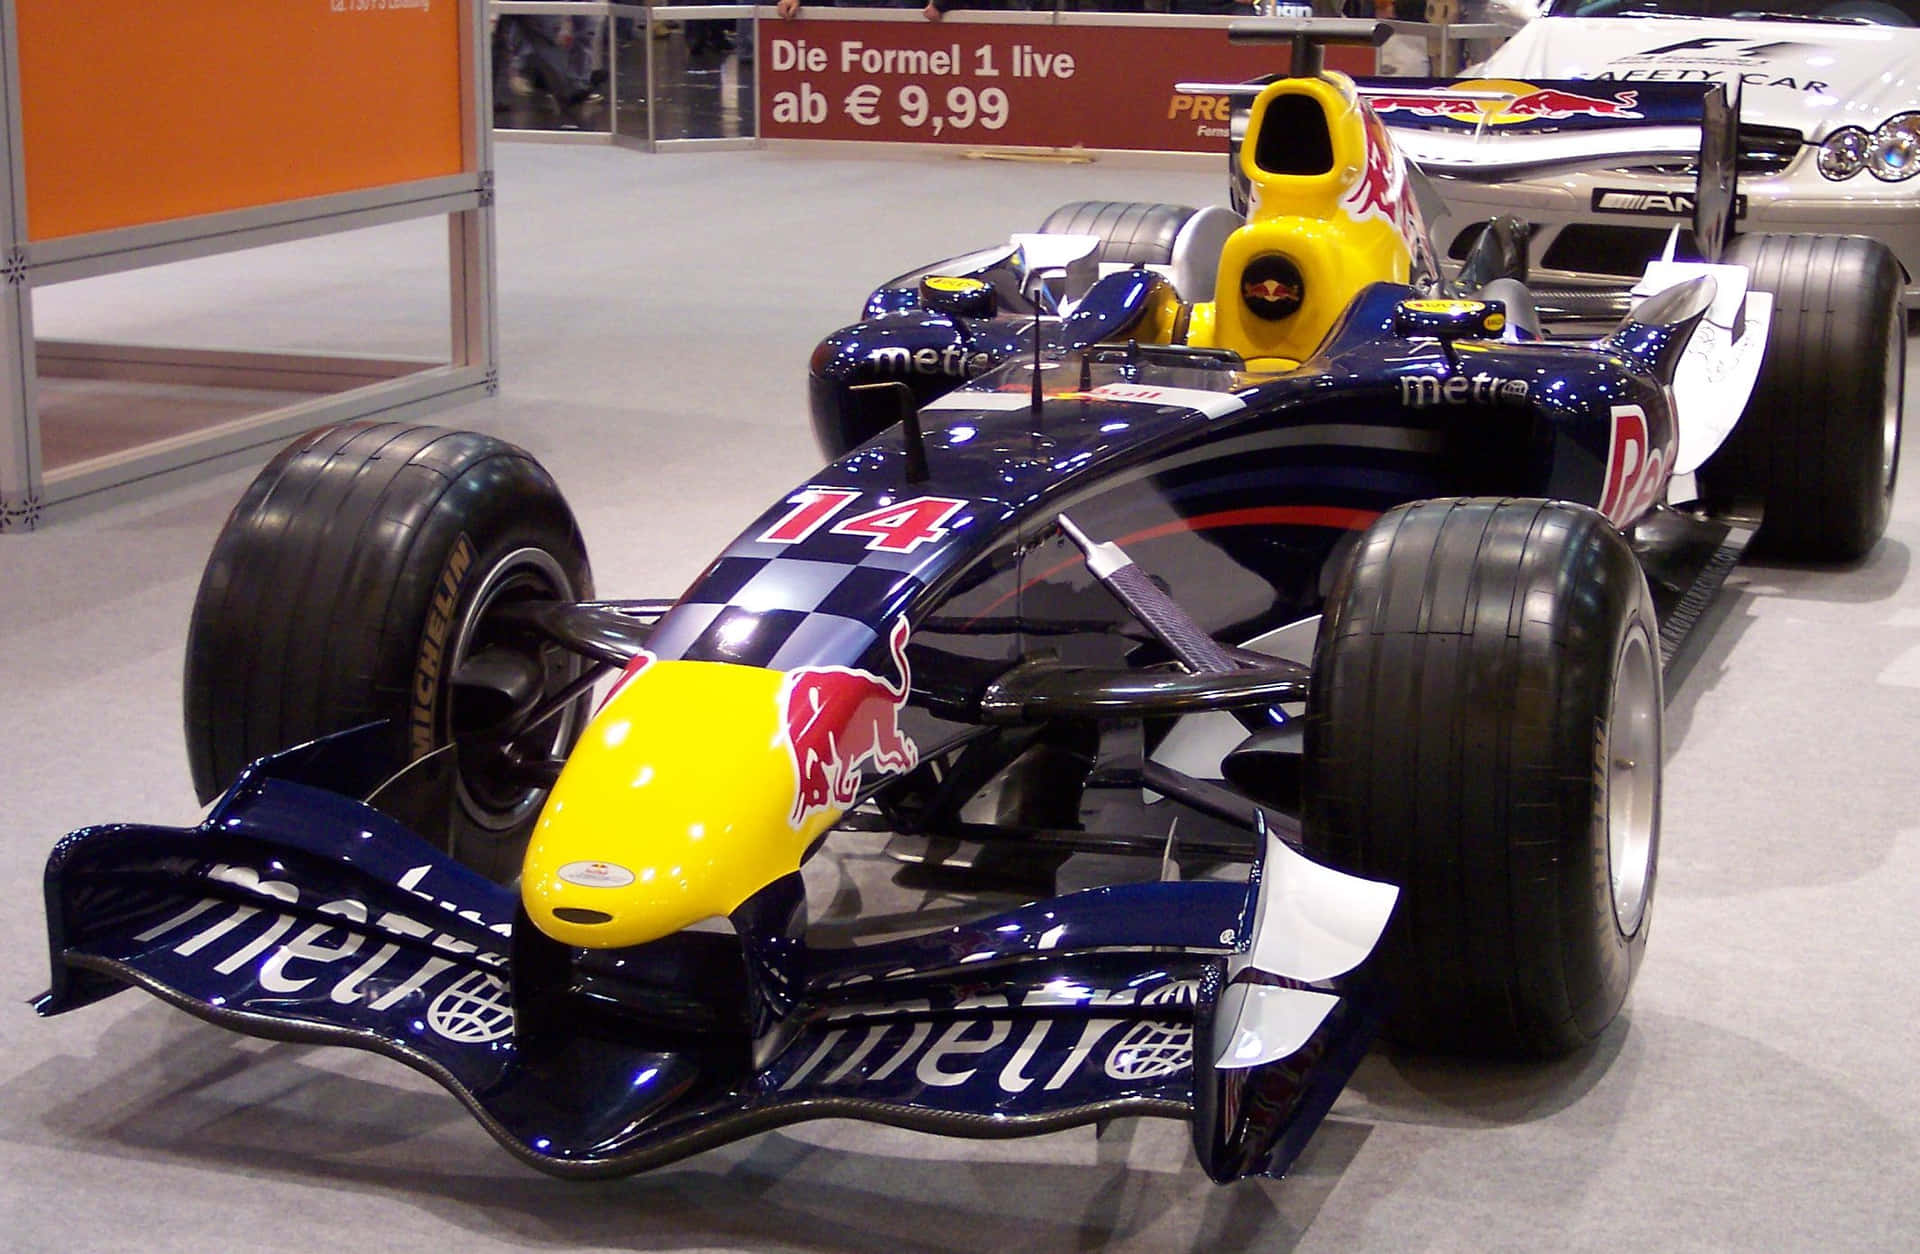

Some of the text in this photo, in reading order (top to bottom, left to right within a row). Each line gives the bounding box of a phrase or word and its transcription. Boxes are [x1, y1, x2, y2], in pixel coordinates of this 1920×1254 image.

[772, 40, 1076, 79] Die Formel 1 live
[1580, 69, 1829, 94] AFETY CAR
[772, 82, 1010, 137] ab € 9,99
[1168, 95, 1230, 120] PRE
[756, 485, 969, 554] 14
[411, 537, 471, 762] MICHELIN
